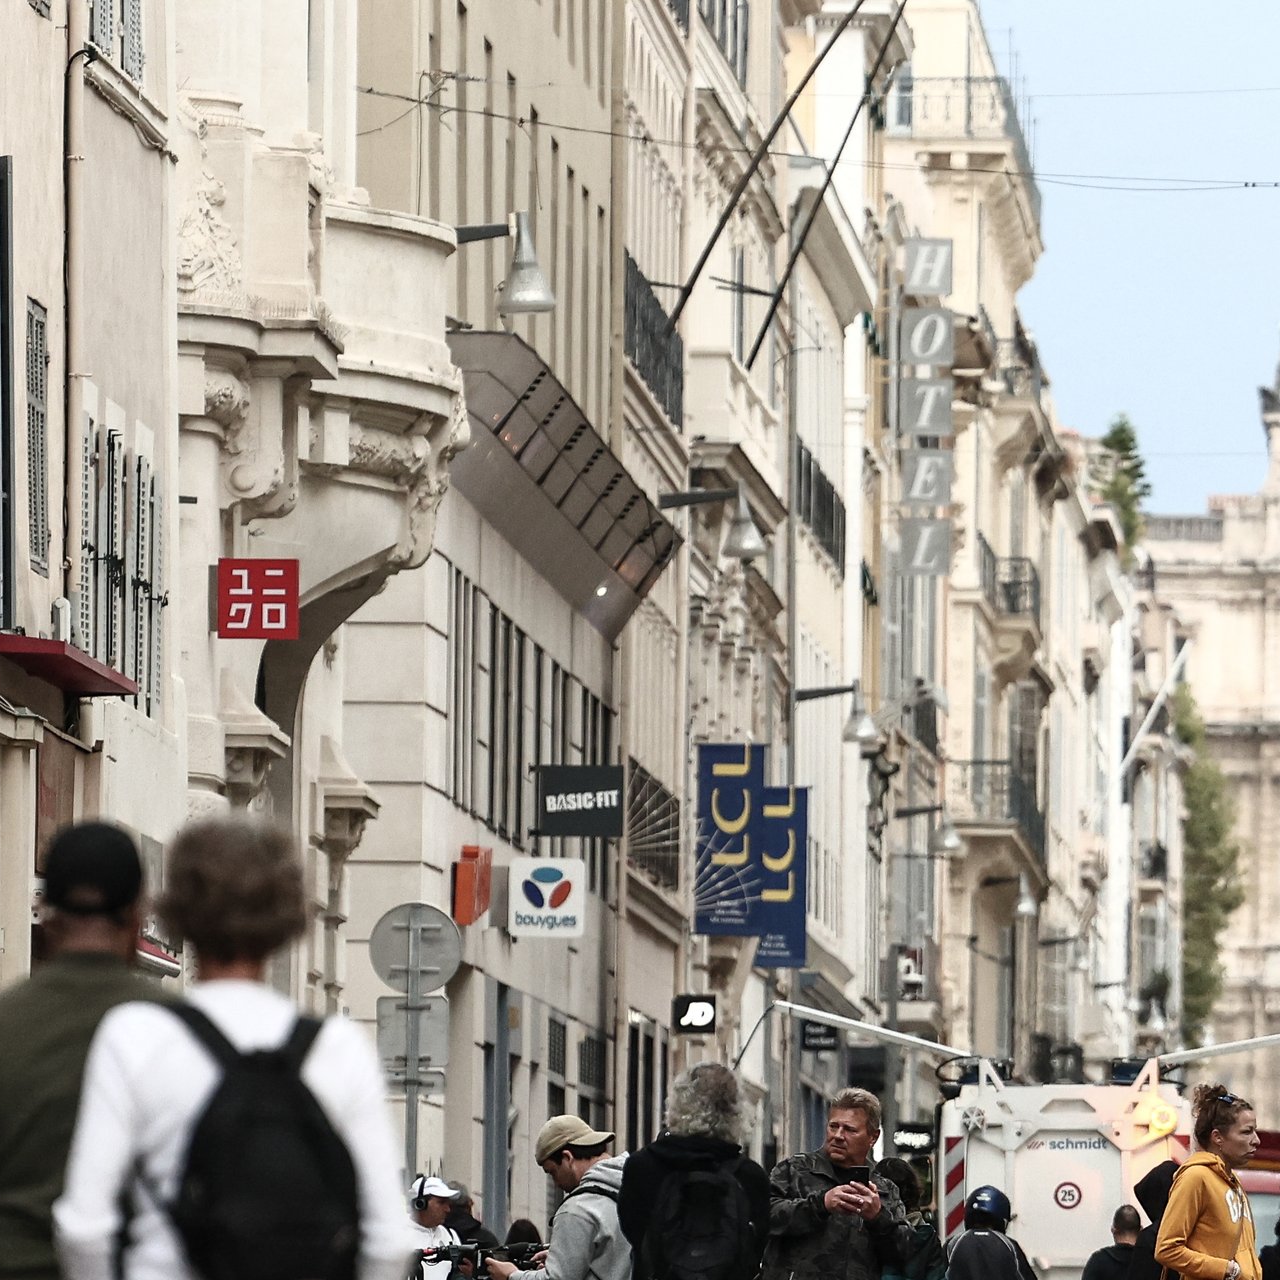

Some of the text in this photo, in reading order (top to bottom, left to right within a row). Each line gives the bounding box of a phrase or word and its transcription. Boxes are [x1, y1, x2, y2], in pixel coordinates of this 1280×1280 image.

[908, 245, 948, 569] HOTEL
[711, 742, 752, 866] LCL
[761, 784, 796, 902] LCL
[515, 911, 577, 930] bouygues
[1049, 1138, 1108, 1150] schmidt
[1060, 1190, 1075, 1202] 25
